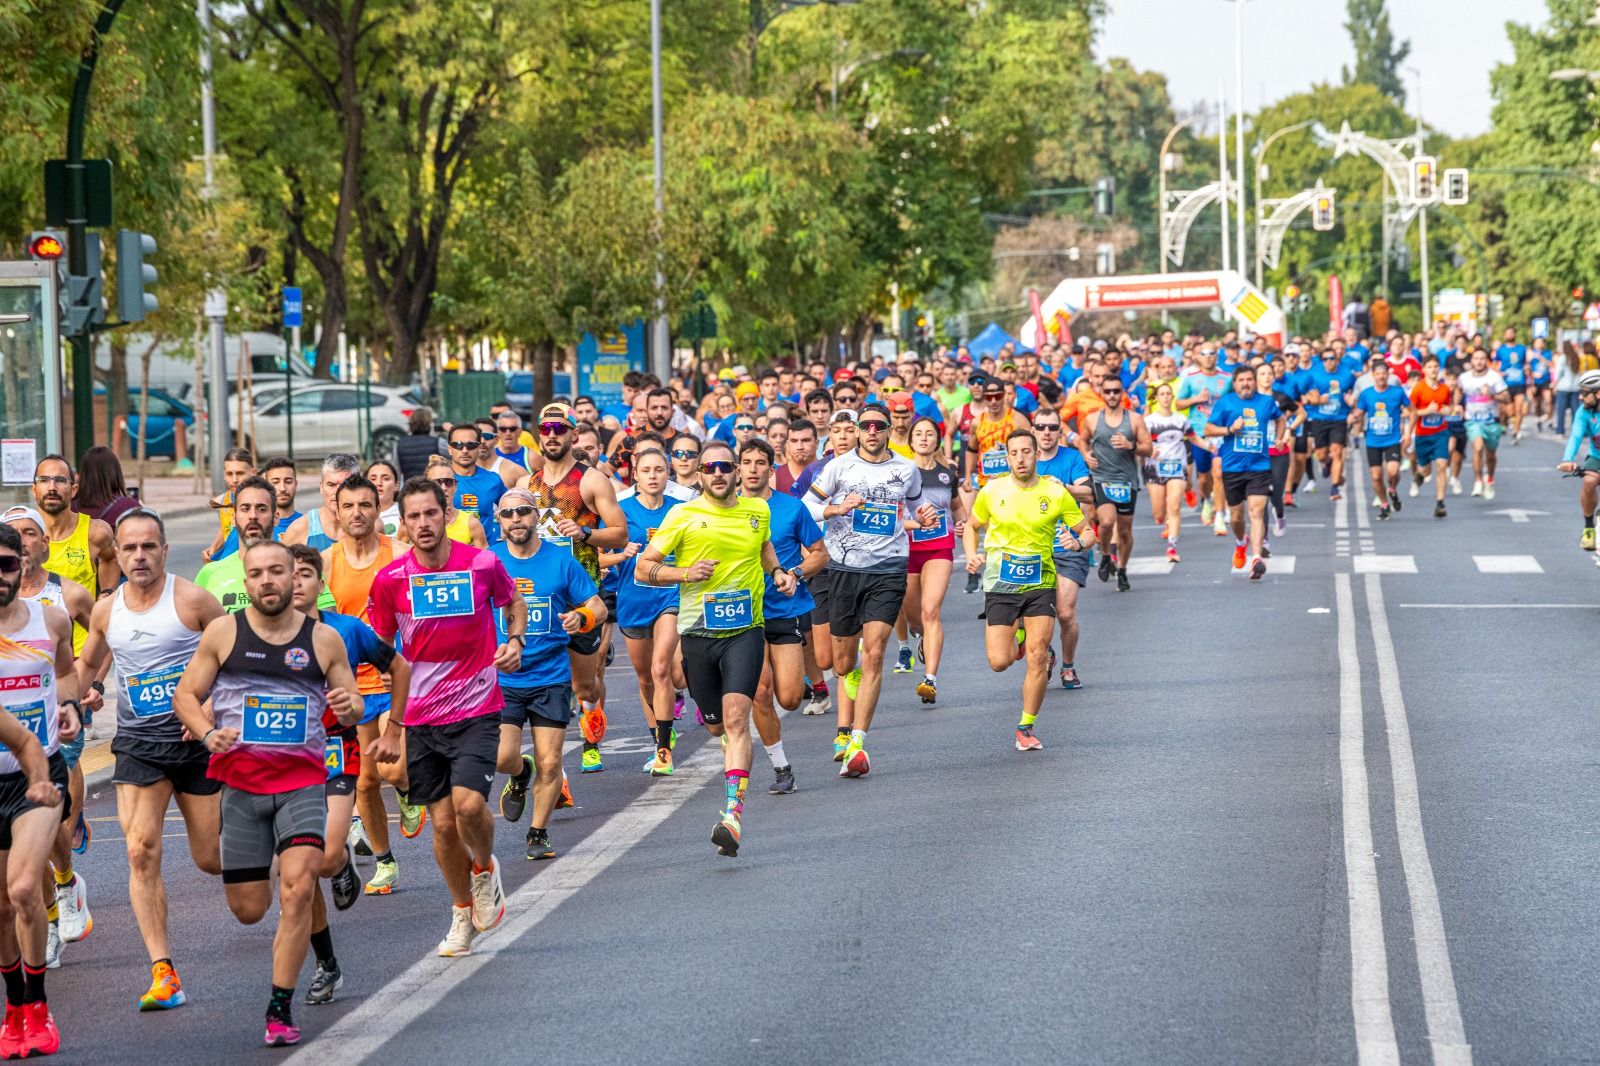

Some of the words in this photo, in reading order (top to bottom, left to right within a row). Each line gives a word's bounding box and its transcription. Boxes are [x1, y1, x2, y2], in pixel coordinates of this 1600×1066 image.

[861, 512, 889, 526] 743
[1007, 563, 1034, 576] 765
[423, 586, 460, 604] 151
[714, 602, 745, 618] 564
[0, 676, 40, 689] PAR
[139, 681, 177, 702] 496
[255, 711, 297, 729] 025
